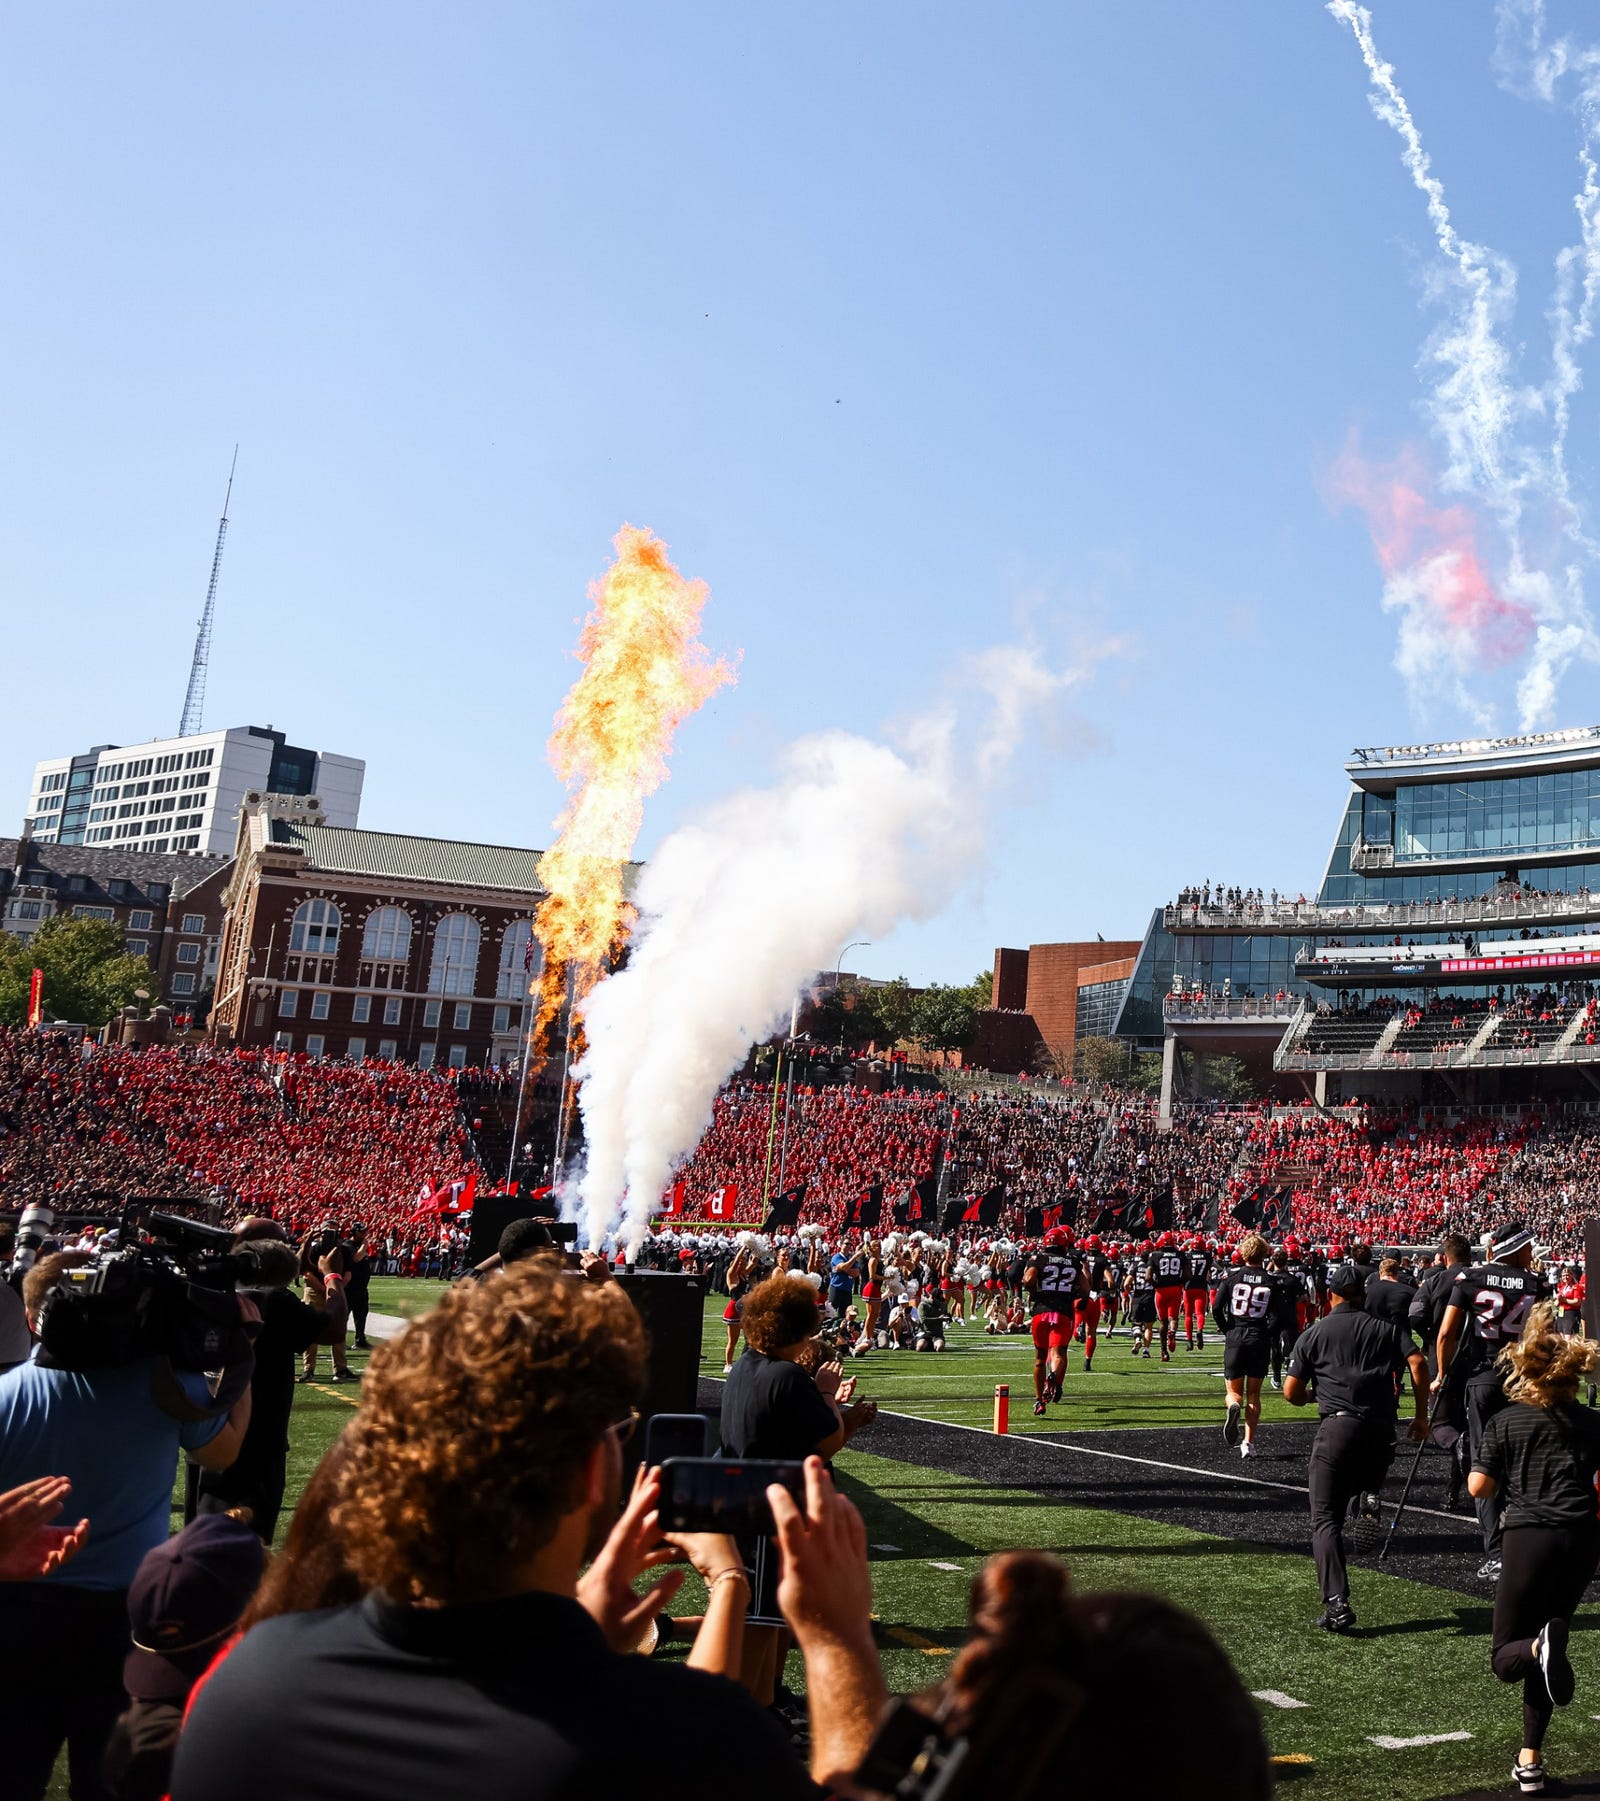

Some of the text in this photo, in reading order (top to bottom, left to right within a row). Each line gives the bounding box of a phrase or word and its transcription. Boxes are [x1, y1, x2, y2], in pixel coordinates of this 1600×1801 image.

[1048, 1255, 1072, 1266] THOMPSON
[1159, 1257, 1181, 1276] 99
[1041, 1265, 1077, 1292] 22
[1486, 1274, 1524, 1290] HOLCOMB
[1230, 1283, 1272, 1319] 89
[1474, 1289, 1537, 1340] 24
